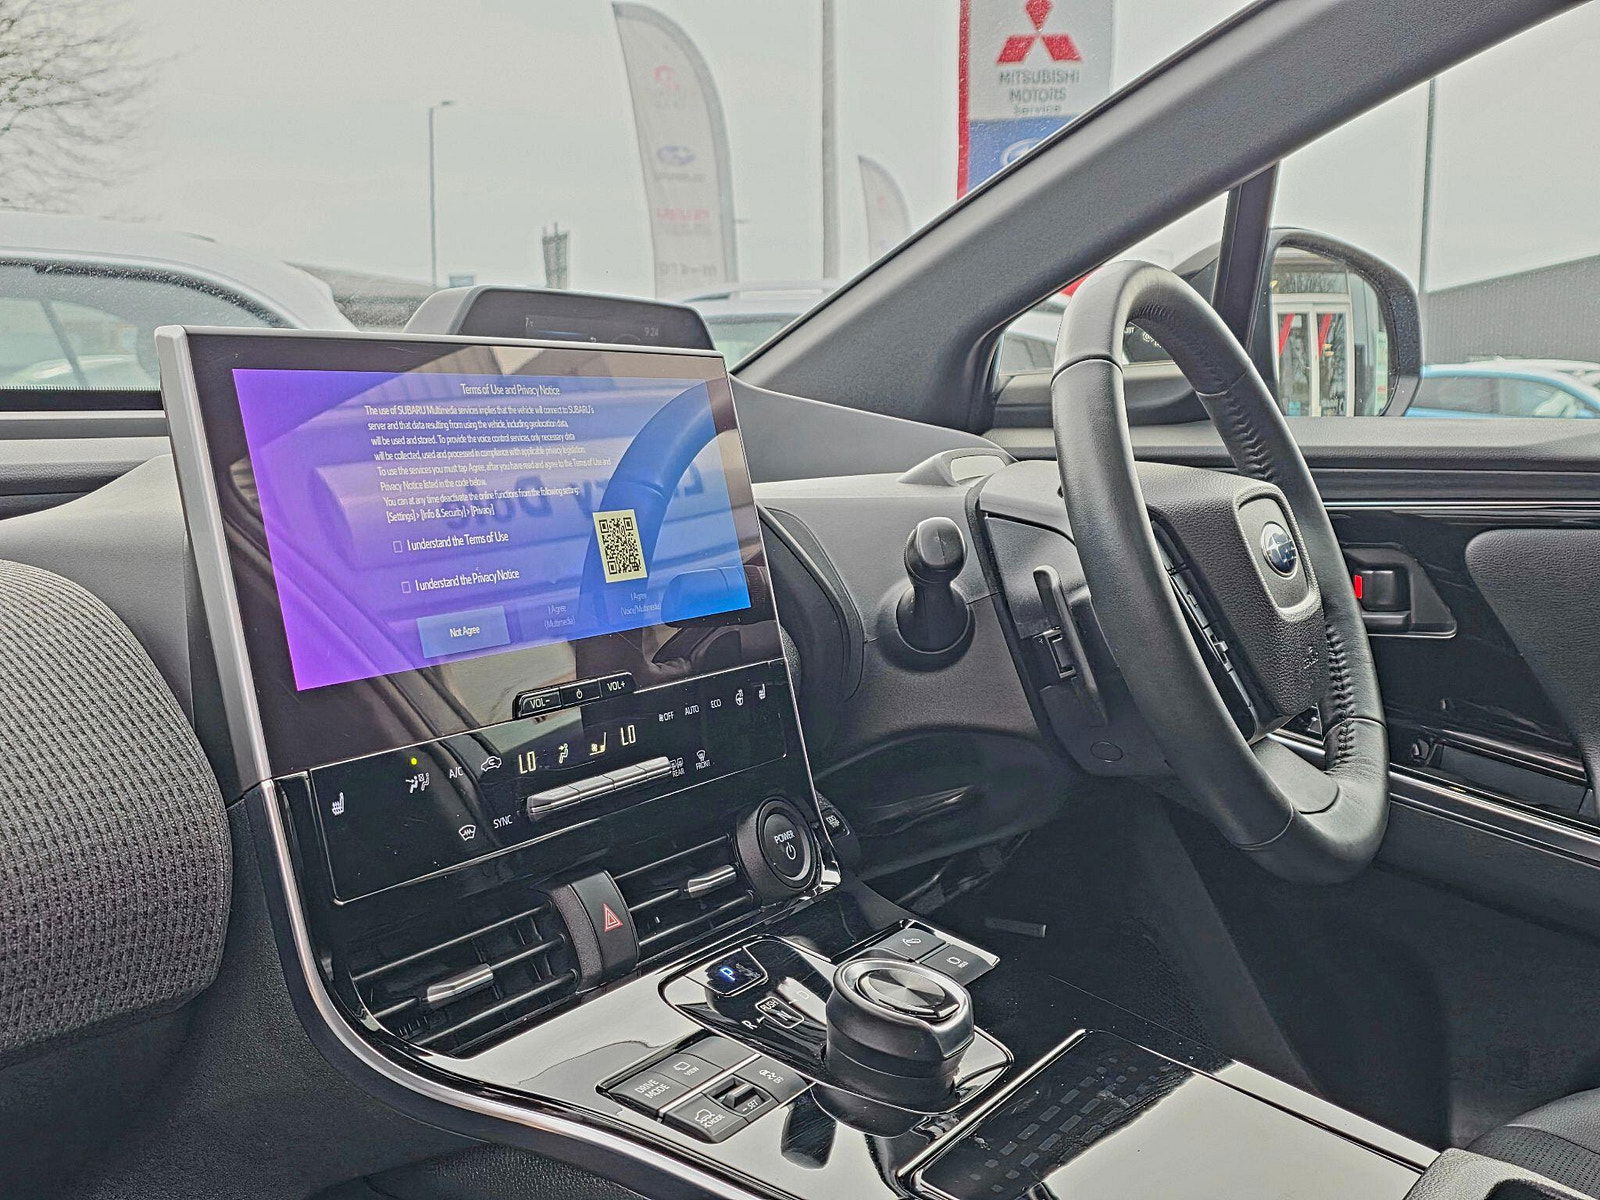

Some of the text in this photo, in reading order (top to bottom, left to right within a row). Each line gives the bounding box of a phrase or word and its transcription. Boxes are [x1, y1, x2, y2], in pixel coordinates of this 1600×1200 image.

[999, 69, 1080, 84] MITSUBISHI
[1008, 88, 1066, 102] MOTORS
[460, 383, 560, 396] Terms of Use and Privacy Notice
[364, 405, 378, 415] The
[378, 406, 390, 415] use
[390, 405, 396, 415] of
[397, 405, 426, 415] SUBARU
[426, 405, 458, 415] Multimedia
[457, 406, 479, 414] services
[496, 405, 508, 414] that
[507, 405, 517, 414] the
[517, 405, 534, 414] vehicle
[535, 405, 543, 414] will
[368, 421, 386, 430] server
[386, 420, 398, 430] and
[399, 420, 412, 430] that
[412, 420, 425, 430] data
[425, 420, 448, 431] resulting
[448, 420, 462, 429] from
[463, 420, 478, 430] using
[478, 420, 488, 428] the
[506, 419, 529, 430] including
[370, 436, 382, 446] will
[382, 436, 390, 445] be
[390, 436, 405, 445] used
[406, 436, 417, 444] and
[437, 434, 446, 444] To
[447, 434, 467, 445] provide
[466, 434, 477, 443] the
[477, 434, 492, 442] voice
[491, 434, 509, 442] control
[530, 433, 541, 442] only
[374, 451, 384, 461] will
[385, 451, 394, 460] be
[422, 450, 436, 459] used
[436, 449, 447, 458] and
[448, 448, 474, 460] processed
[474, 448, 480, 457] in
[509, 446, 521, 456] with
[377, 466, 386, 476] To
[386, 468, 398, 476] use
[398, 466, 409, 475] the
[409, 466, 432, 474] services
[432, 466, 444, 475] you
[444, 464, 459, 473] must
[458, 465, 468, 474] tap
[500, 463, 510, 472] you
[534, 461, 544, 470] and
[380, 481, 402, 492] Privacy
[402, 480, 423, 490] Notice
[423, 479, 438, 490] listed
[444, 479, 454, 488] the
[454, 478, 469, 487] code
[382, 497, 396, 506] You
[396, 498, 408, 506] can
[408, 497, 415, 505] at
[415, 497, 426, 506] any
[426, 495, 440, 504] time
[440, 494, 468, 503] deactivate
[468, 492, 479, 501] the
[494, 490, 519, 499] functions
[519, 488, 531, 498] from
[531, 488, 540, 497] the
[540, 487, 563, 497] following
[435, 508, 442, 518] &
[406, 531, 509, 551] I understand the Terms of Use
[415, 569, 520, 592] I understand the Privacy Notice
[450, 625, 480, 638] Not Agree
[684, 704, 700, 716] AUTO
[710, 698, 722, 709] ECO
[663, 710, 674, 721] OFF
[695, 759, 711, 771] FRONT
[448, 766, 464, 779] A/C
[672, 768, 686, 778] REAR
[493, 814, 514, 829] SYNC
[773, 829, 796, 844] POWER
[720, 967, 736, 981] P
[760, 999, 780, 1012] PUSH
[777, 1010, 793, 1021] N
[742, 1020, 758, 1030] R
[634, 1079, 660, 1094] DRIVE
[644, 1083, 671, 1099] MODE
[747, 1100, 759, 1110] SET
